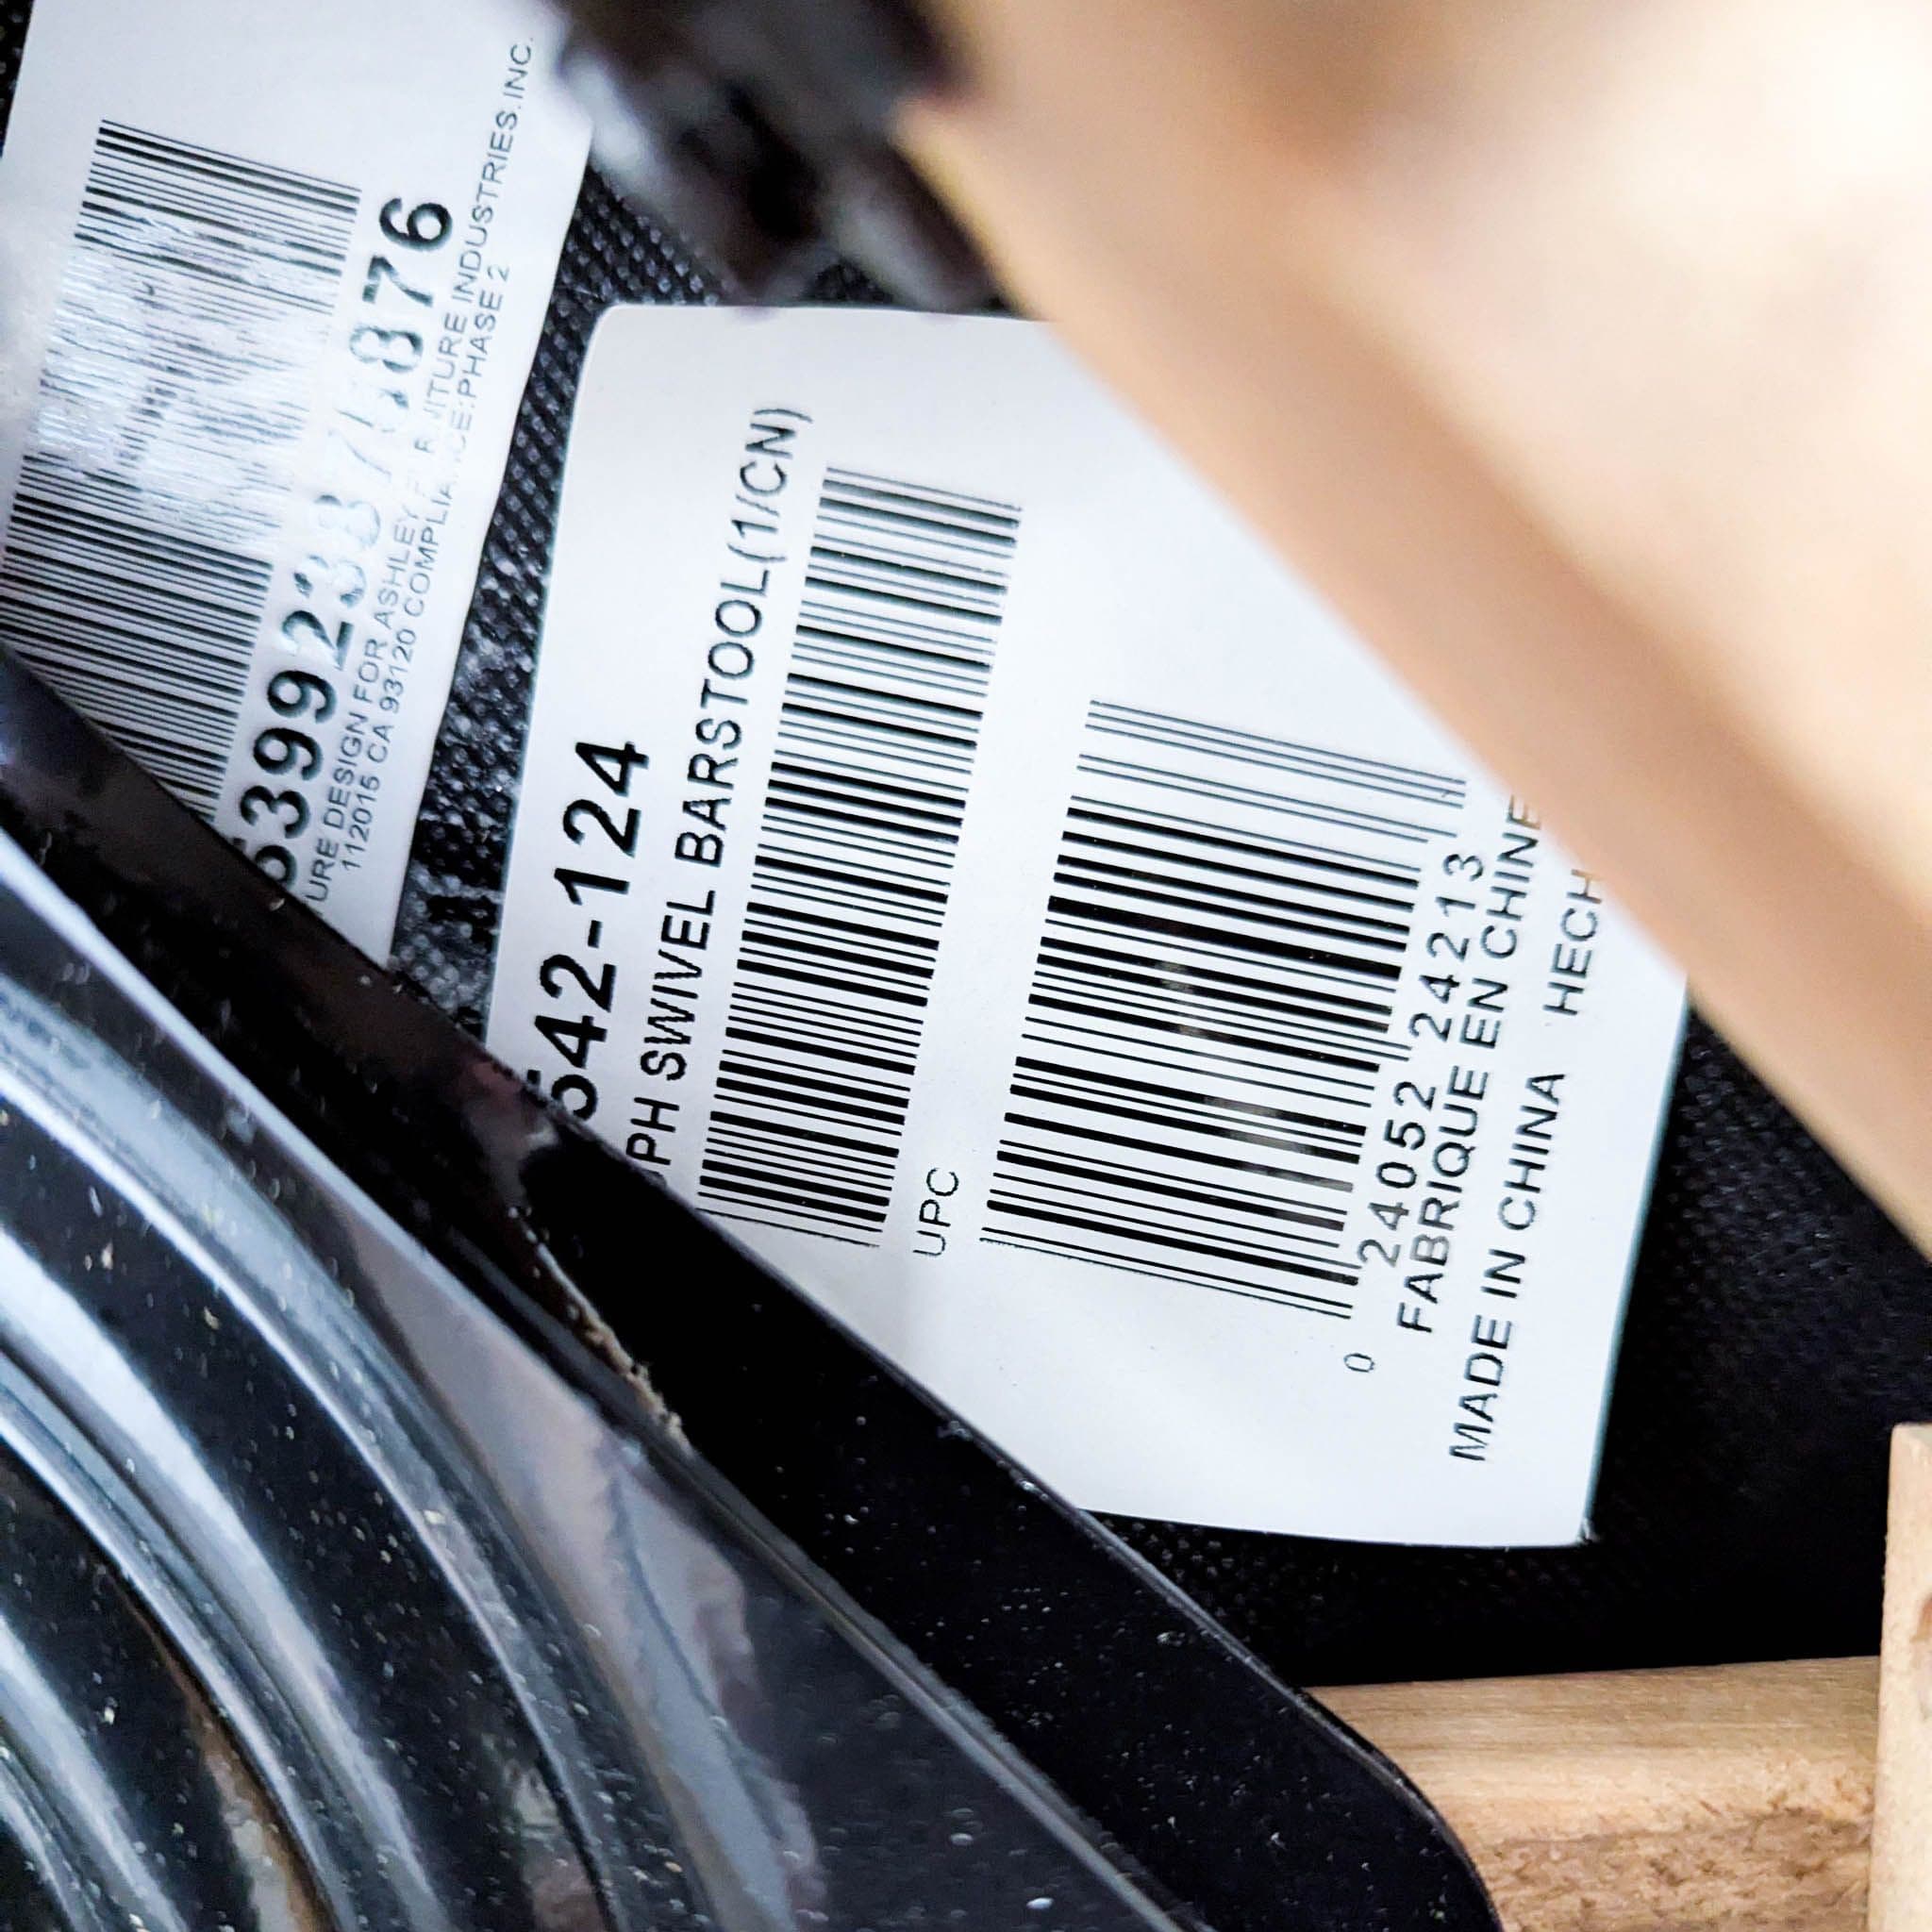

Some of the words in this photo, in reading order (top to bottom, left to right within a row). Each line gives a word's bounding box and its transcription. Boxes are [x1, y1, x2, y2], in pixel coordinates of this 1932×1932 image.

[487, 264, 510, 283] 2
[305, 838, 339, 903] URE
[322, 711, 369, 830] DESIGN
[353, 638, 388, 704] FOR
[375, 505, 420, 629] ASHLEY
[379, 628, 416, 715] 93120
[675, 408, 813, 868] BARSTOOL(1/CN)
[366, 724, 394, 764] CA
[341, 775, 381, 872] 112015
[1479, 794, 1541, 959] CHINE
[640, 890, 717, 1081] SWIVEL
[1459, 977, 1509, 1050] EN
[1543, 869, 1603, 1016] HECH
[1357, 1081, 1436, 1268] 24052
[1408, 853, 1484, 1043] 24213
[625, 1096, 680, 1174] PH
[1397, 1065, 1489, 1333] FABRIQUE
[1498, 1074, 1565, 1231] CHINA
[913, 1168, 959, 1257] UPC
[1481, 1249, 1526, 1299] IN
[1448, 1315, 1511, 1461] MADE
